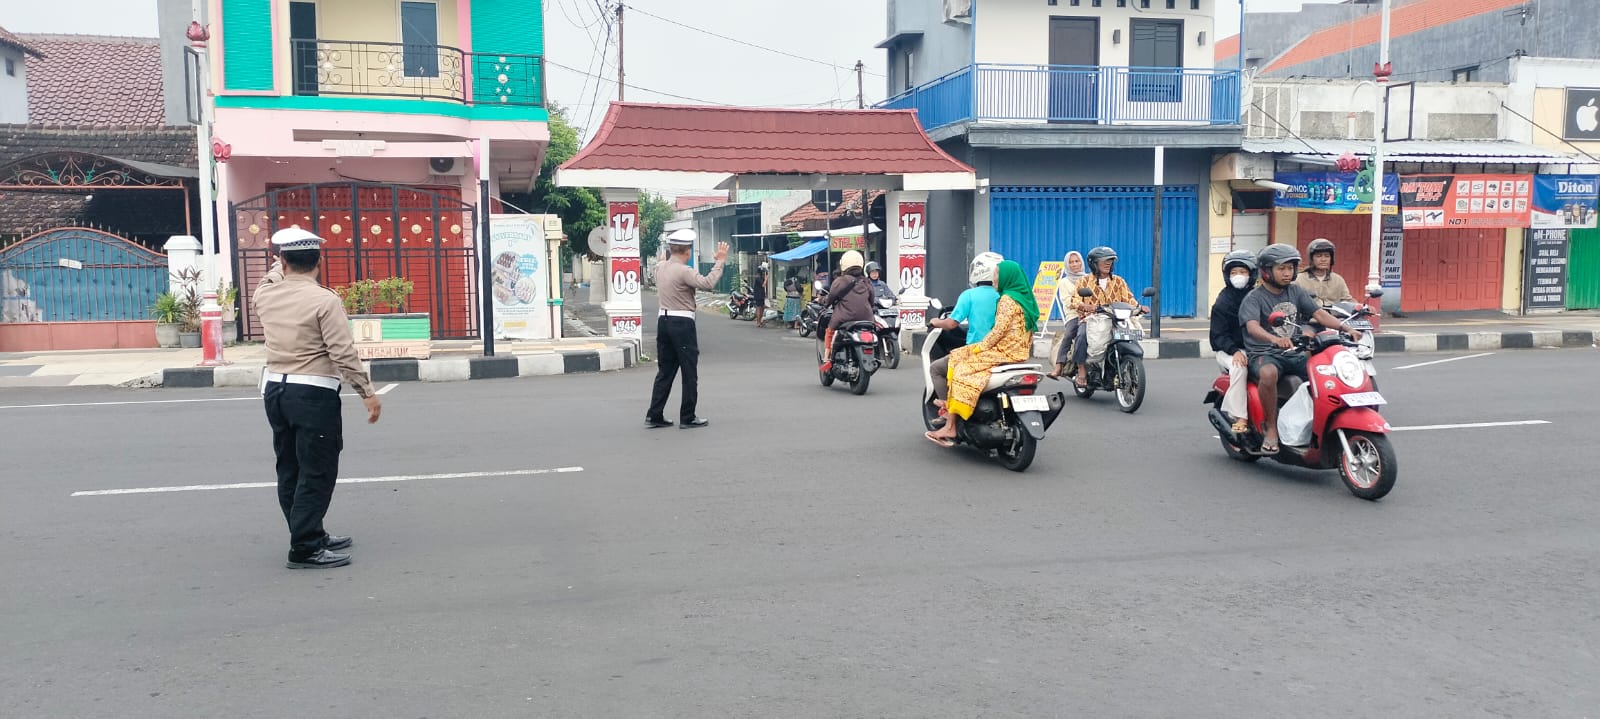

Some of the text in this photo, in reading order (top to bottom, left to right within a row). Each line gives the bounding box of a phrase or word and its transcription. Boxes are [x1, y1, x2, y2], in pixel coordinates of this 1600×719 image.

[1558, 181, 1593, 193] Diton
[612, 213, 635, 242] 17
[901, 213, 922, 240] 17
[613, 270, 639, 294] 08
[900, 267, 923, 289] 08
[615, 319, 637, 332] 1945
[902, 312, 922, 323] 2025
